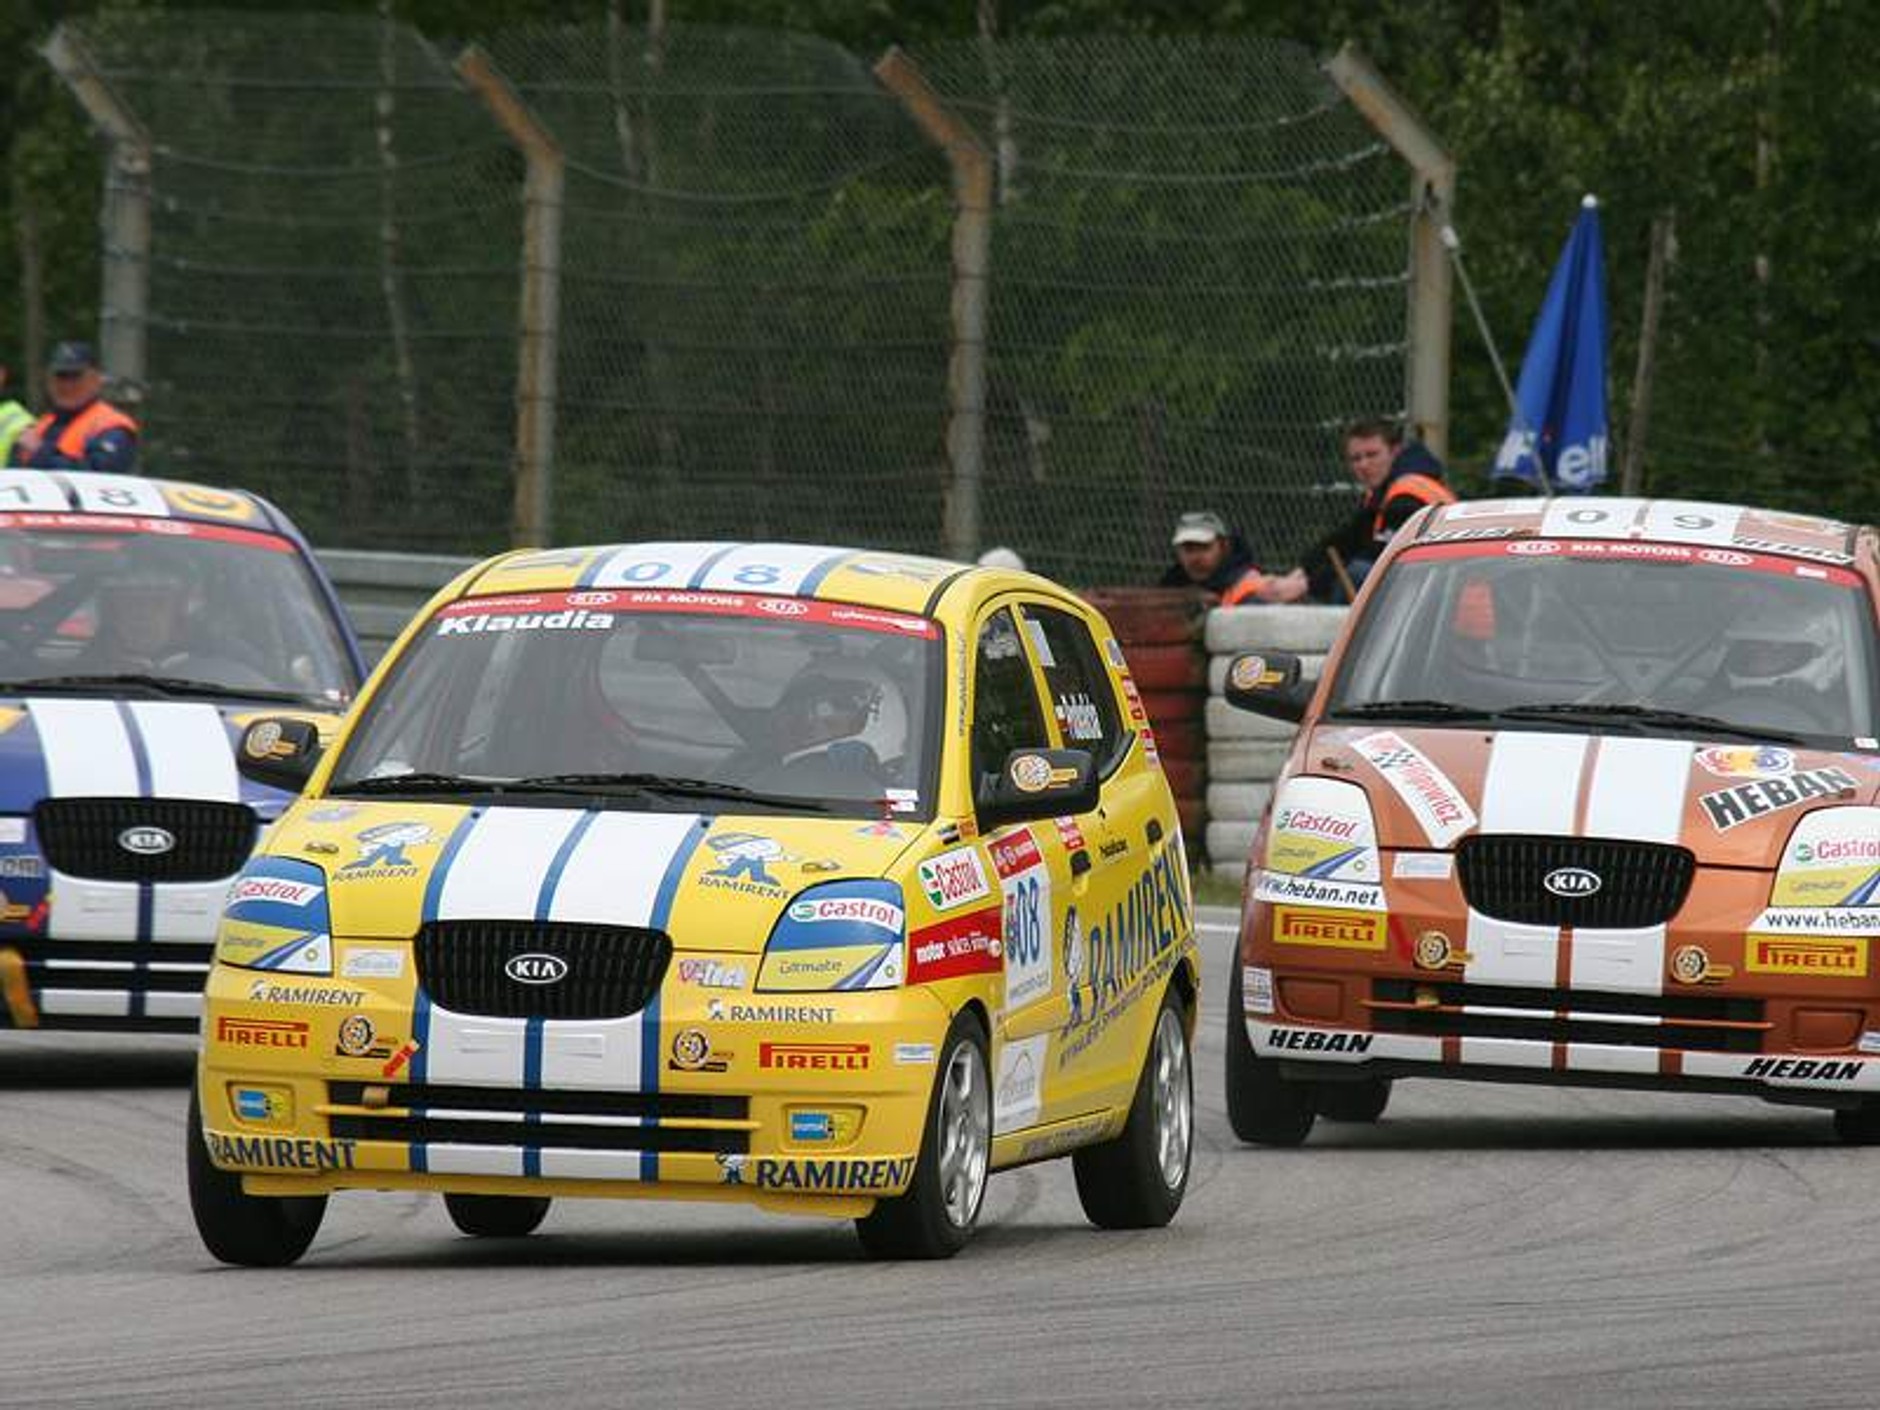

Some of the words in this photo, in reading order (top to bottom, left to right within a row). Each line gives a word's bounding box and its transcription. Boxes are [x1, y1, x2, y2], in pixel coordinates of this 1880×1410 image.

[620, 562, 672, 583] 0
[732, 564, 782, 584] 8
[436, 610, 614, 637] Klaudia
[1702, 767, 1856, 829] HEBAN
[1289, 809, 1359, 838] Castrol
[1816, 839, 1880, 860] Castrol
[332, 866, 418, 882] RAMIRENT
[698, 875, 791, 900] RAMIRENT
[818, 900, 896, 926] Castrol
[1018, 876, 1041, 966] 08
[1282, 913, 1377, 942] PIRELLI
[1758, 941, 1858, 969] PIRELLI
[266, 985, 366, 1007] RAMIRENT
[730, 1005, 836, 1024] RAMIRENT
[218, 1015, 310, 1048] PIRELLI
[1268, 1028, 1374, 1053] HEBAN
[759, 1043, 871, 1070] PIRELLI
[1743, 1057, 1865, 1081] HEBAN
[205, 1131, 357, 1170] RAMIRENT
[756, 1157, 917, 1190] RAMIRENT
